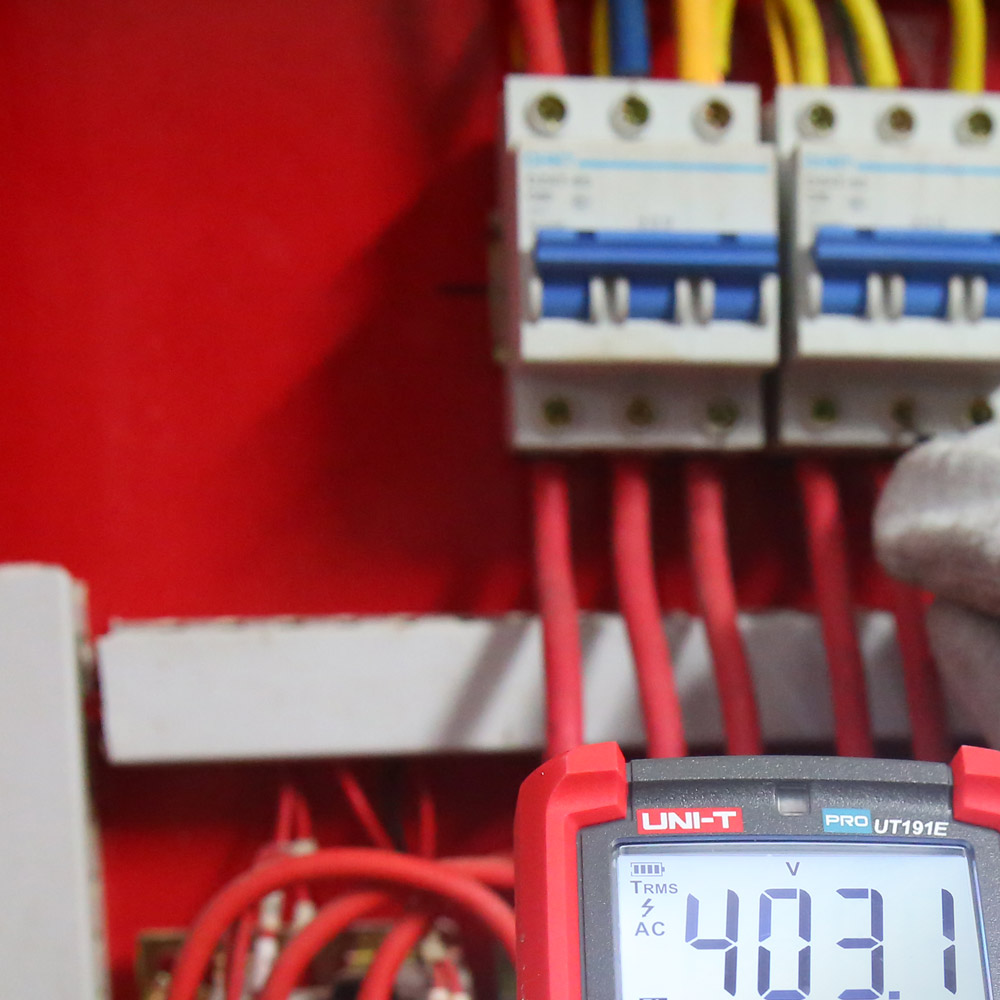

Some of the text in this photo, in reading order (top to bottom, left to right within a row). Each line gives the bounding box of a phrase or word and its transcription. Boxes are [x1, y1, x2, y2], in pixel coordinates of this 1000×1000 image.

[642, 811, 737, 831] UNI-T
[825, 813, 949, 837] PRO UT191E
[786, 862, 800, 876] V
[635, 921, 666, 937] AC
[685, 888, 957, 1000] 403.1
